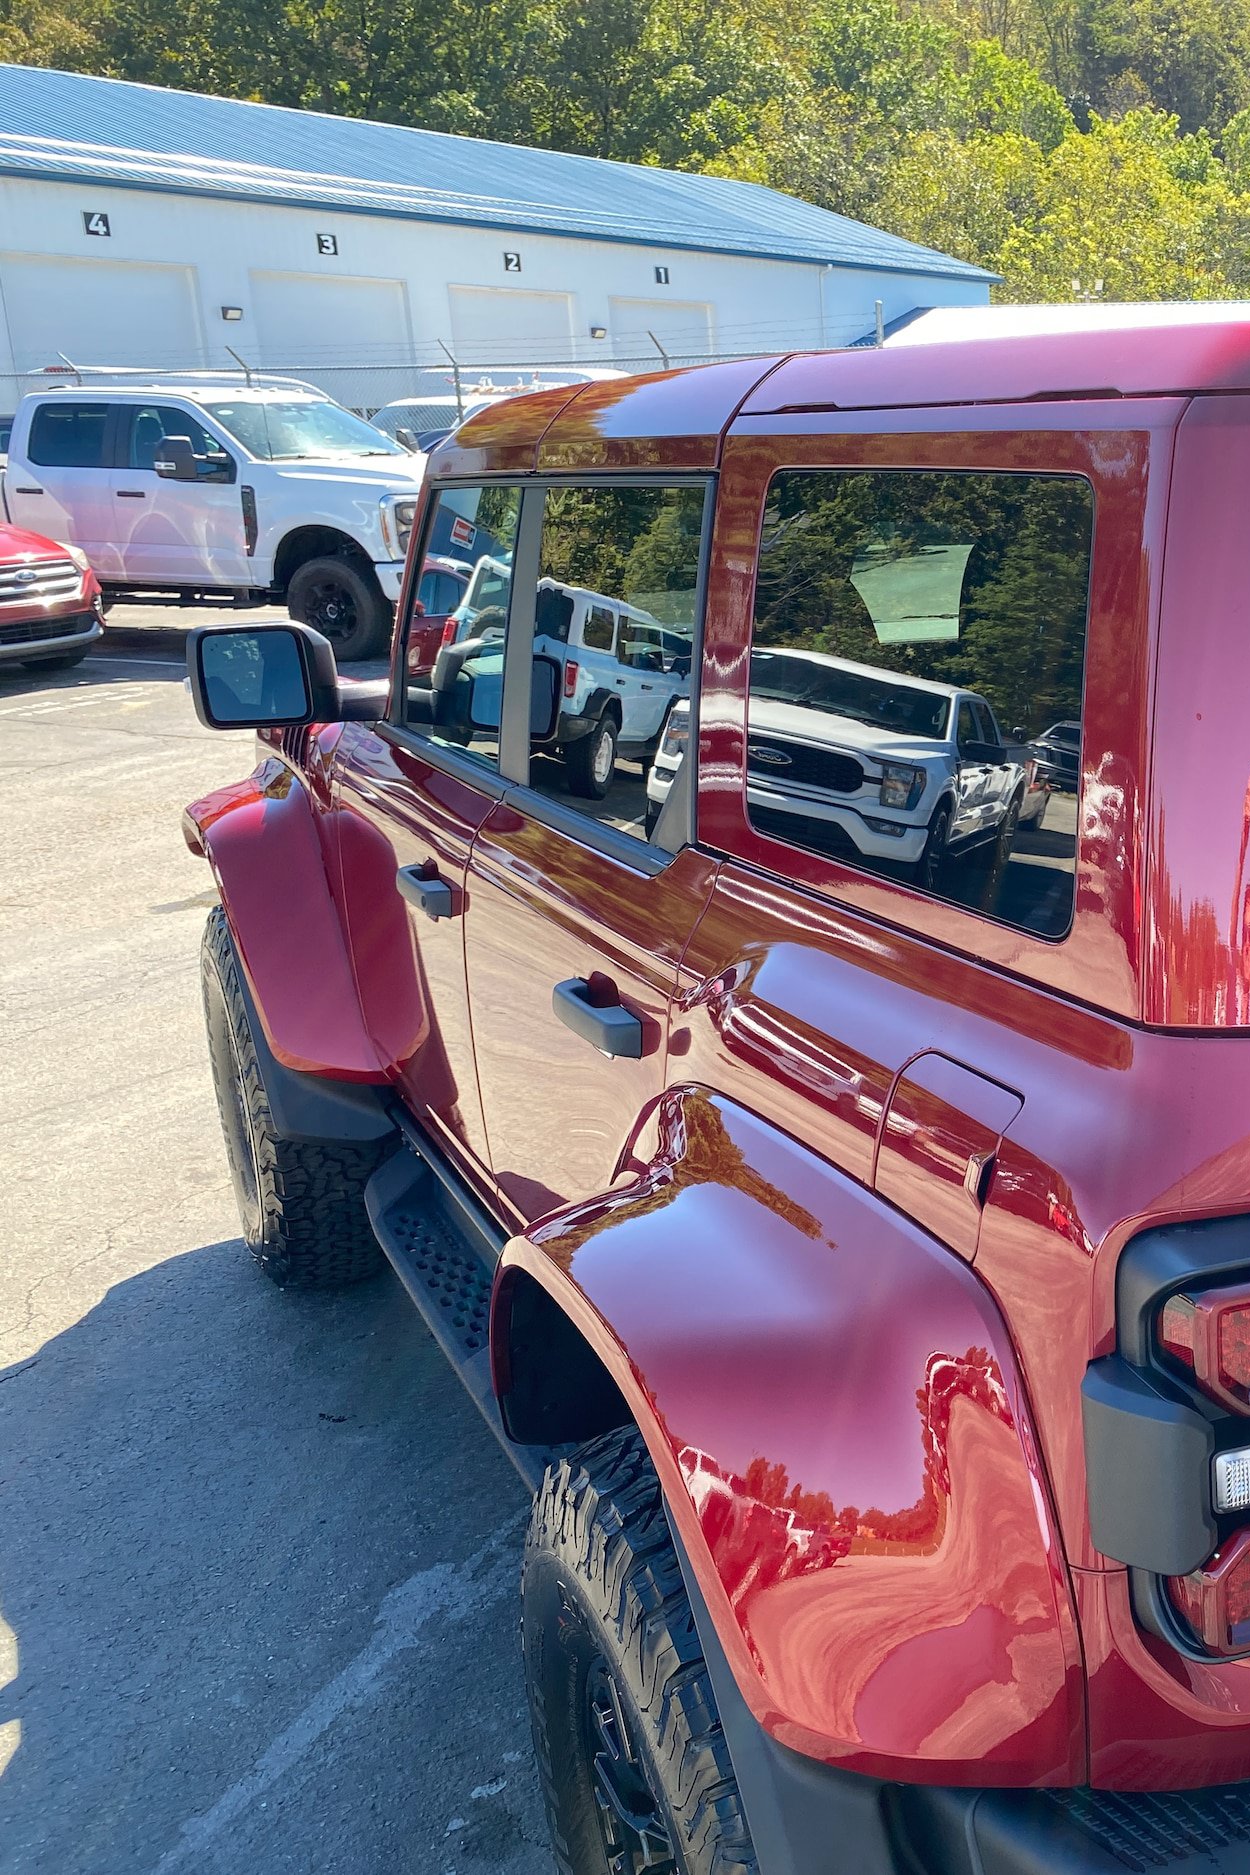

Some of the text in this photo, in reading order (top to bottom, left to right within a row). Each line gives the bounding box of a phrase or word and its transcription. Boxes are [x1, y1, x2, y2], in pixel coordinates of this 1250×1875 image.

[88, 214, 107, 235] 4
[320, 235, 335, 254] 3
[507, 254, 519, 271] 2
[659, 268, 666, 283] 1
